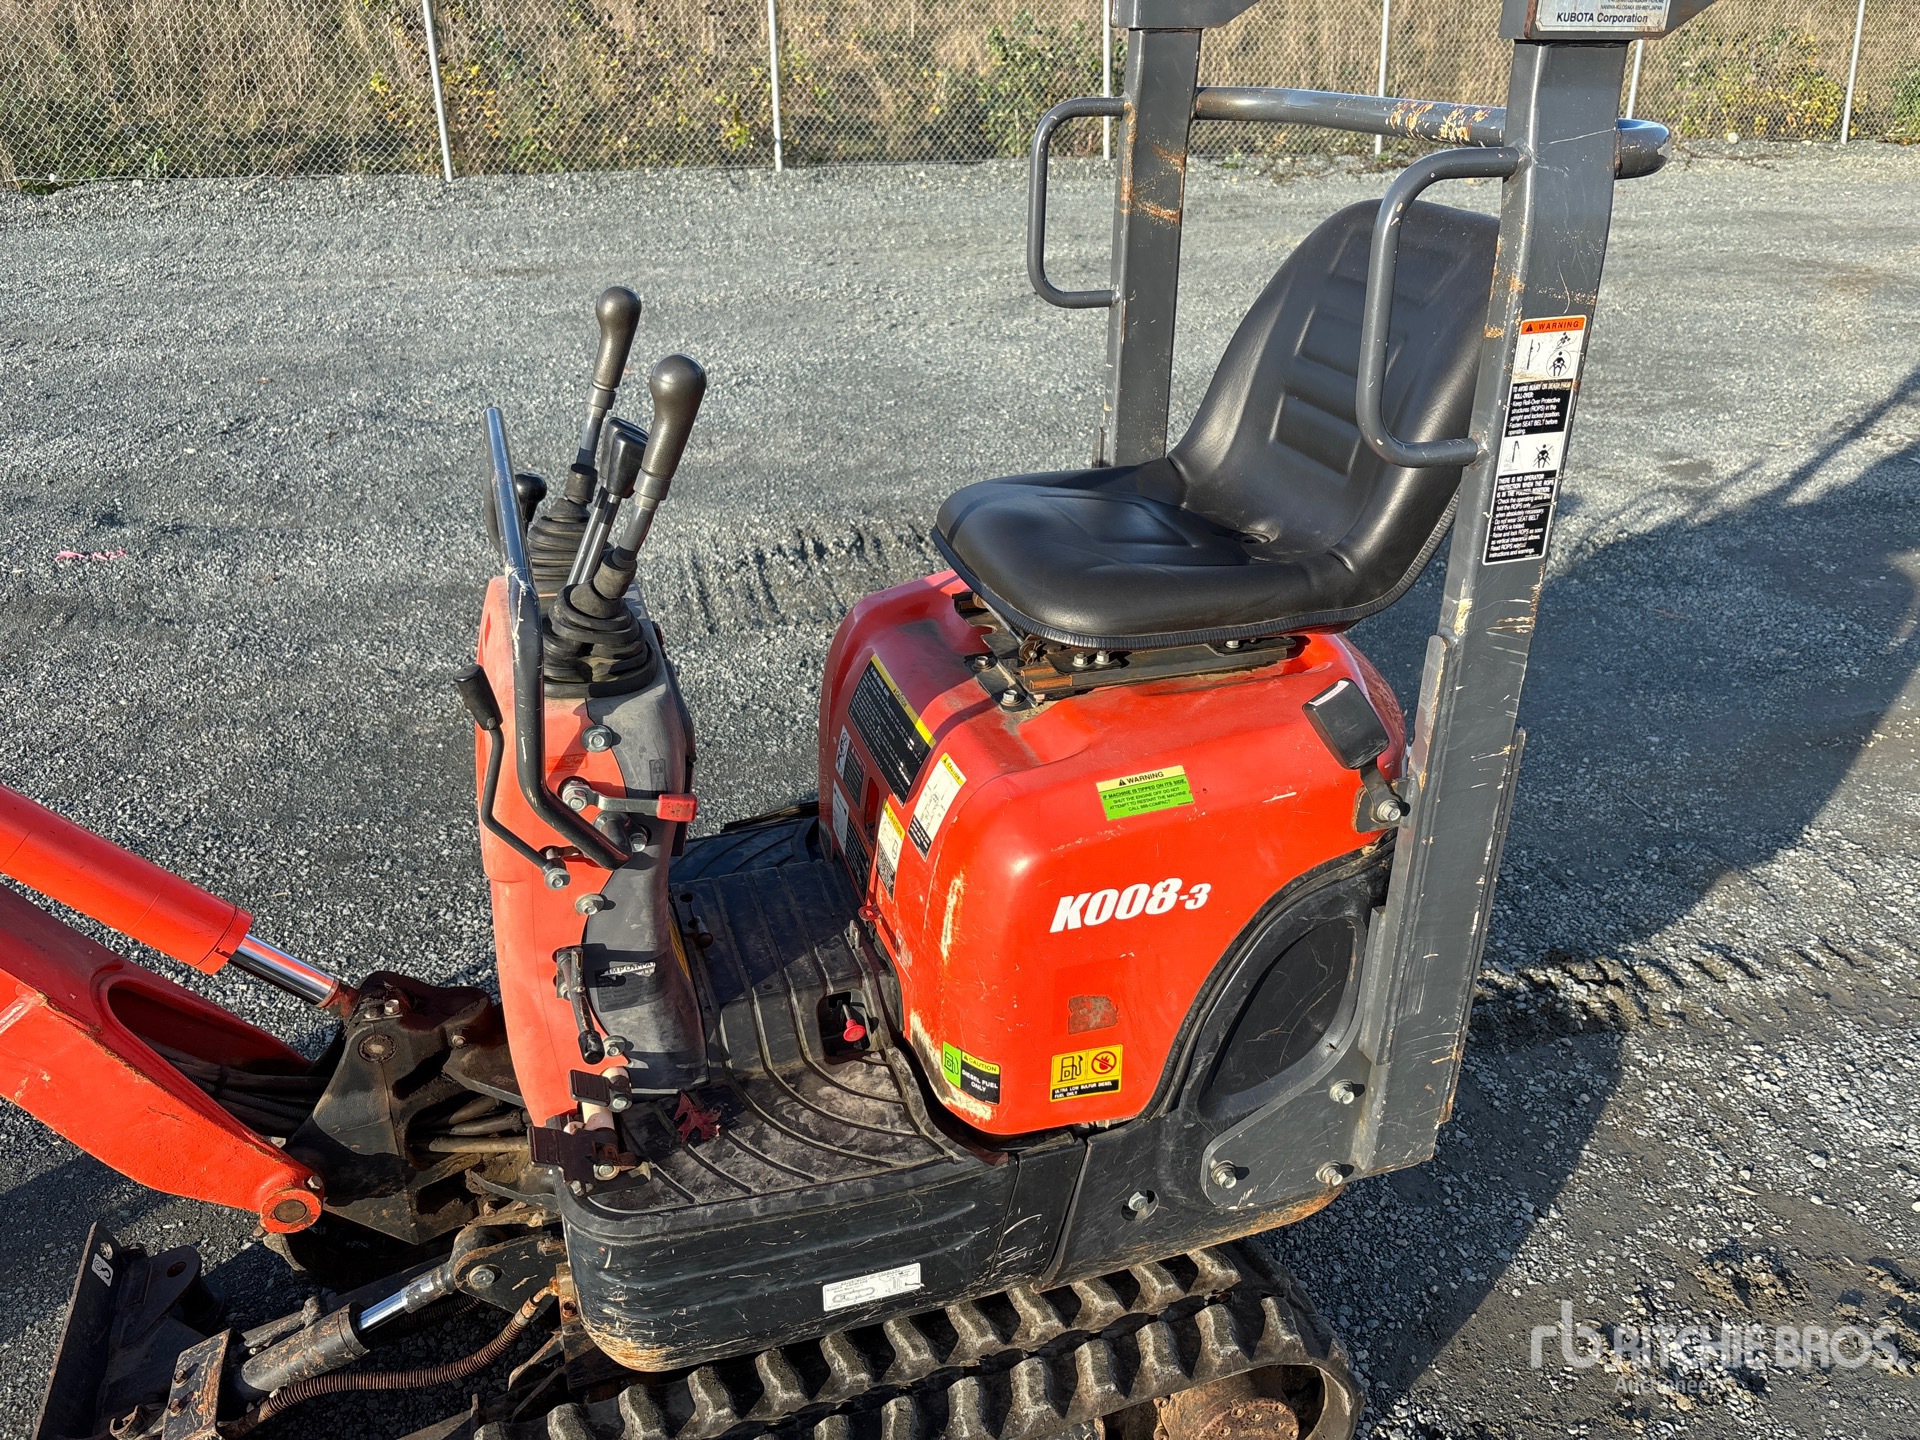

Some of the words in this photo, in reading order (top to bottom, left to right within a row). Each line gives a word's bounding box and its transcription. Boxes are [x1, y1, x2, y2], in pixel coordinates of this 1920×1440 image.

[1557, 12, 1594, 22] KUBOTA
[1597, 12, 1648, 25] Corporation
[1538, 321, 1579, 330] WARNING
[895, 690, 908, 708] CAUTION
[947, 763, 960, 780] CAUTION
[1126, 771, 1165, 784] WARNING
[1108, 790, 1132, 799] MACHINE
[1138, 785, 1155, 793] TIPPED
[1050, 878, 1212, 933] K008-3
[968, 1057, 997, 1072] CAUTION
[962, 1069, 981, 1084] DIESEL
[982, 1080, 999, 1089] FUEL
[1064, 1070, 1071, 1078] D
[971, 1081, 986, 1092] ONLY
